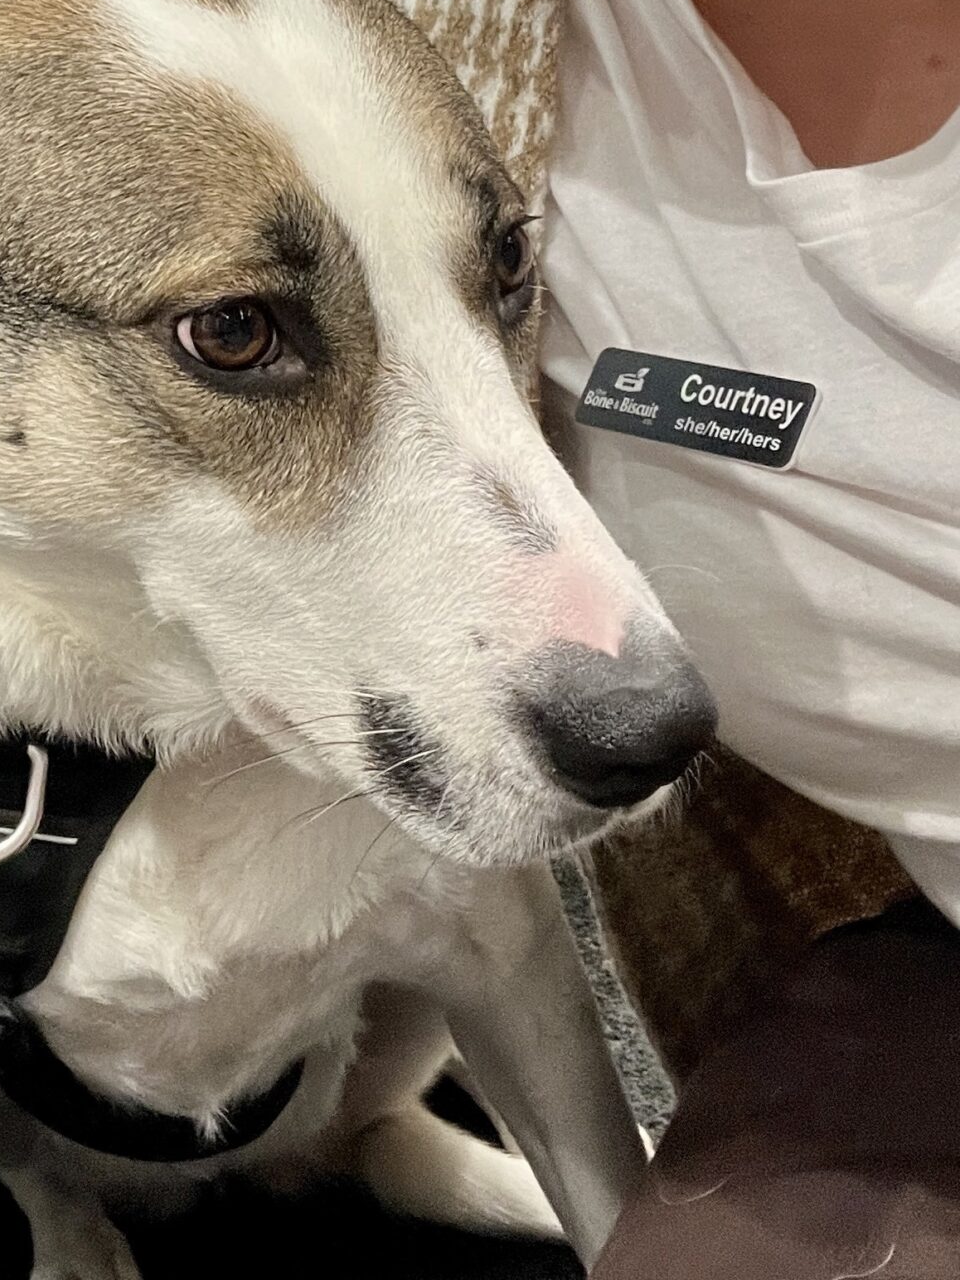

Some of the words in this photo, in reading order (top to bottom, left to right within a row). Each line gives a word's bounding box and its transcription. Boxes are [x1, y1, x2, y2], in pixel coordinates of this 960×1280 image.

[584, 390, 614, 410] Bone
[619, 396, 659, 419] Biscuit
[679, 373, 804, 430] Courtney
[674, 416, 782, 452] she/her/hers
